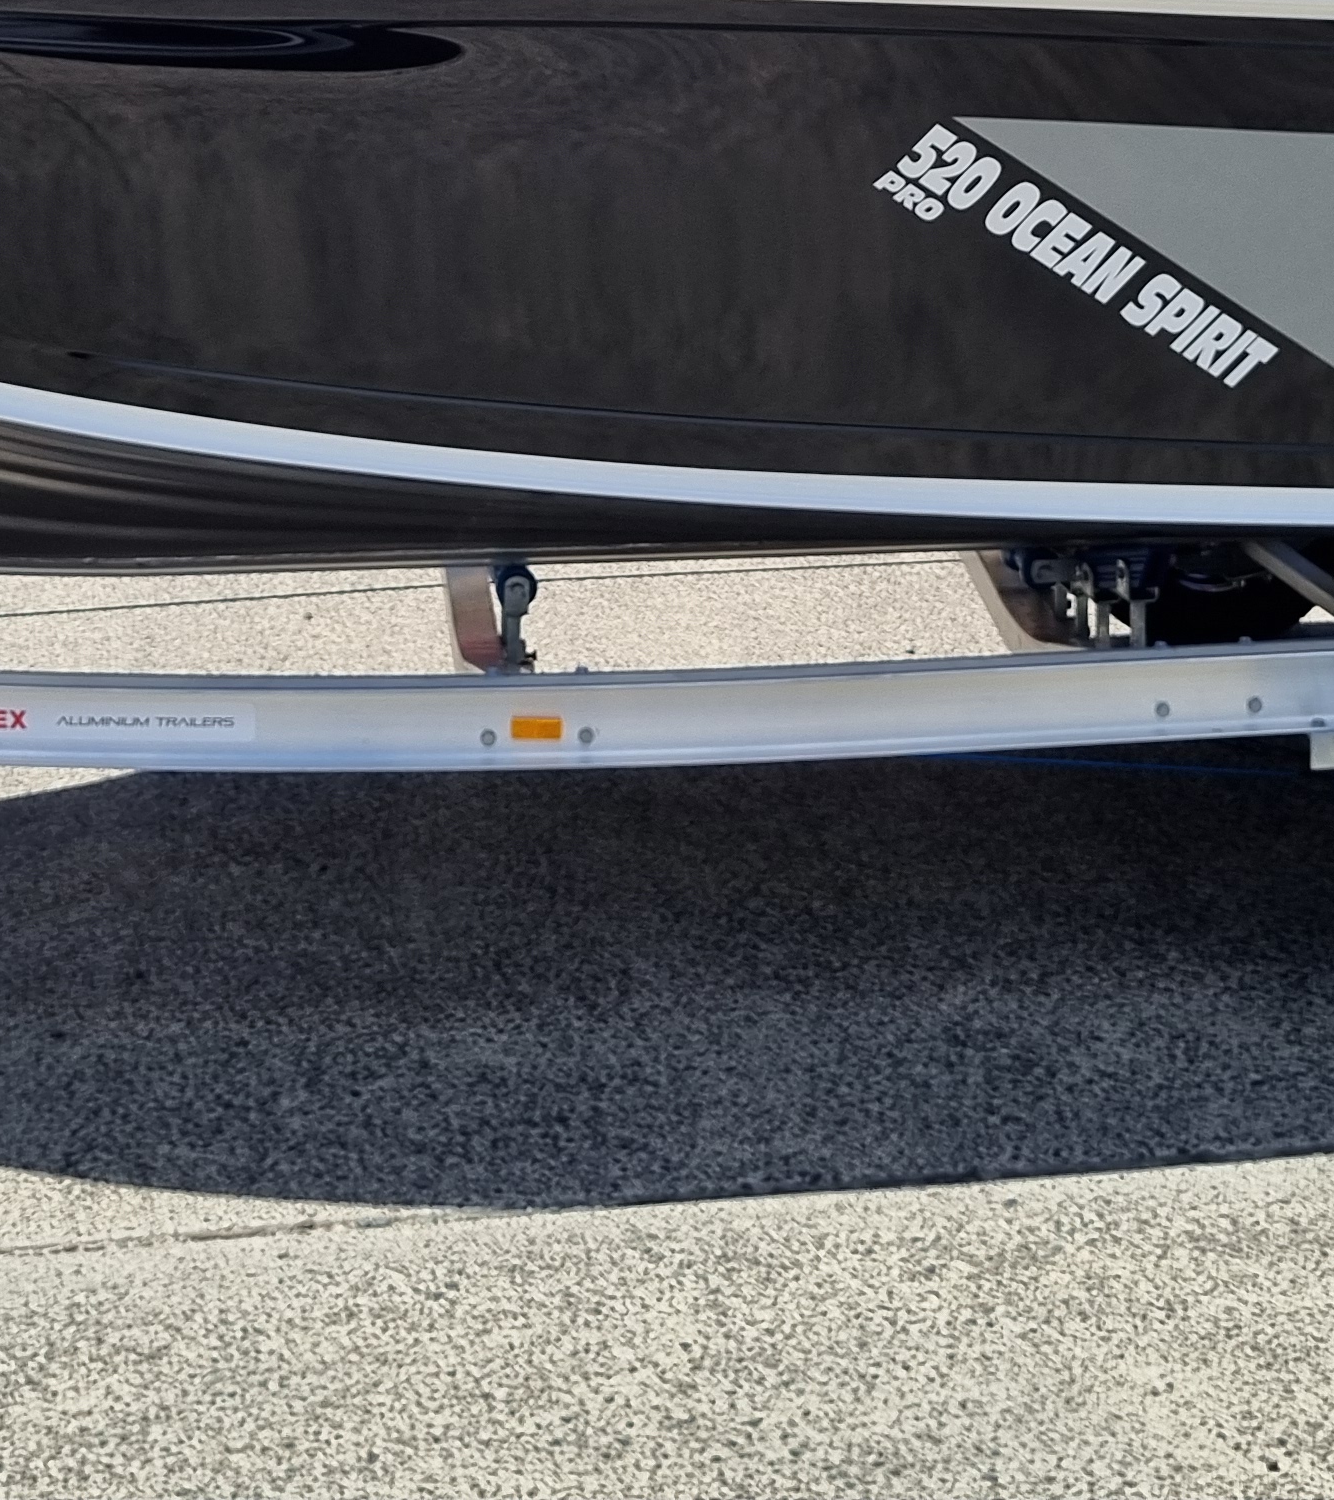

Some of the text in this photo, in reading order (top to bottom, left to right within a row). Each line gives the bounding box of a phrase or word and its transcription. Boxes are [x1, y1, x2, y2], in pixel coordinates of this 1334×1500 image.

[873, 170, 945, 222] PRO
[896, 123, 1279, 388] 520 OCEAN SPIRIT
[56, 715, 150, 727] ALUMINIUM
[155, 716, 235, 728] TRAILERS
